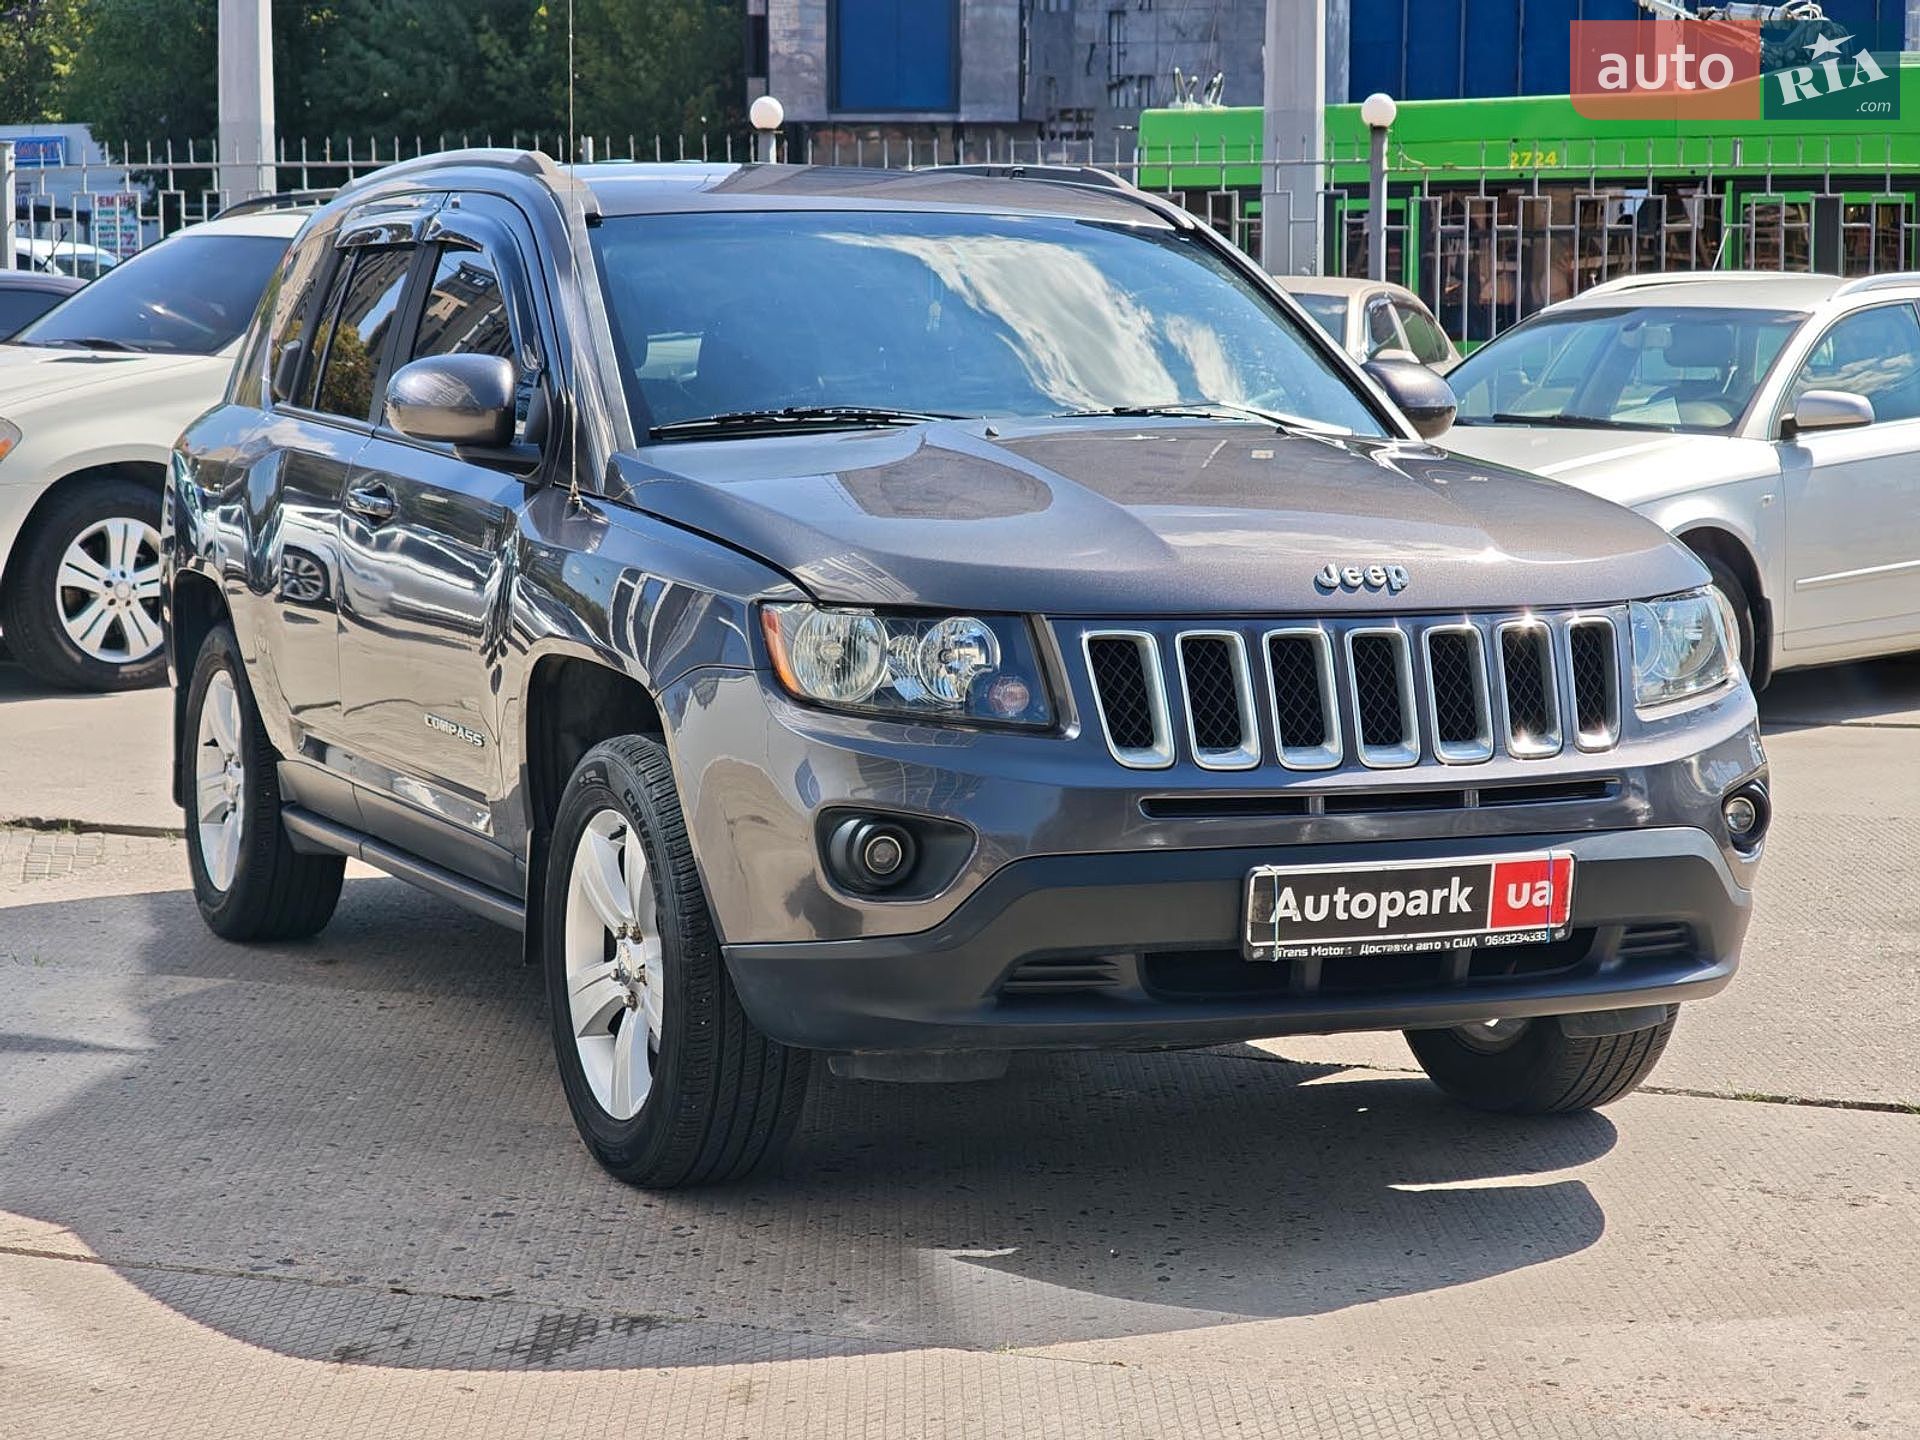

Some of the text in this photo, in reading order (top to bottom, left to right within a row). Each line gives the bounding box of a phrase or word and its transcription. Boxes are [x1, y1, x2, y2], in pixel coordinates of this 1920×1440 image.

[1510, 151, 1557, 167] 2724
[1316, 563, 1409, 592] Jeep
[424, 712, 485, 747] COMPASS
[1269, 876, 1554, 929] Autopark ua
[1276, 946, 1309, 957] Trans
[1360, 943, 1414, 955] Доставка
[1453, 937, 1478, 948] США
